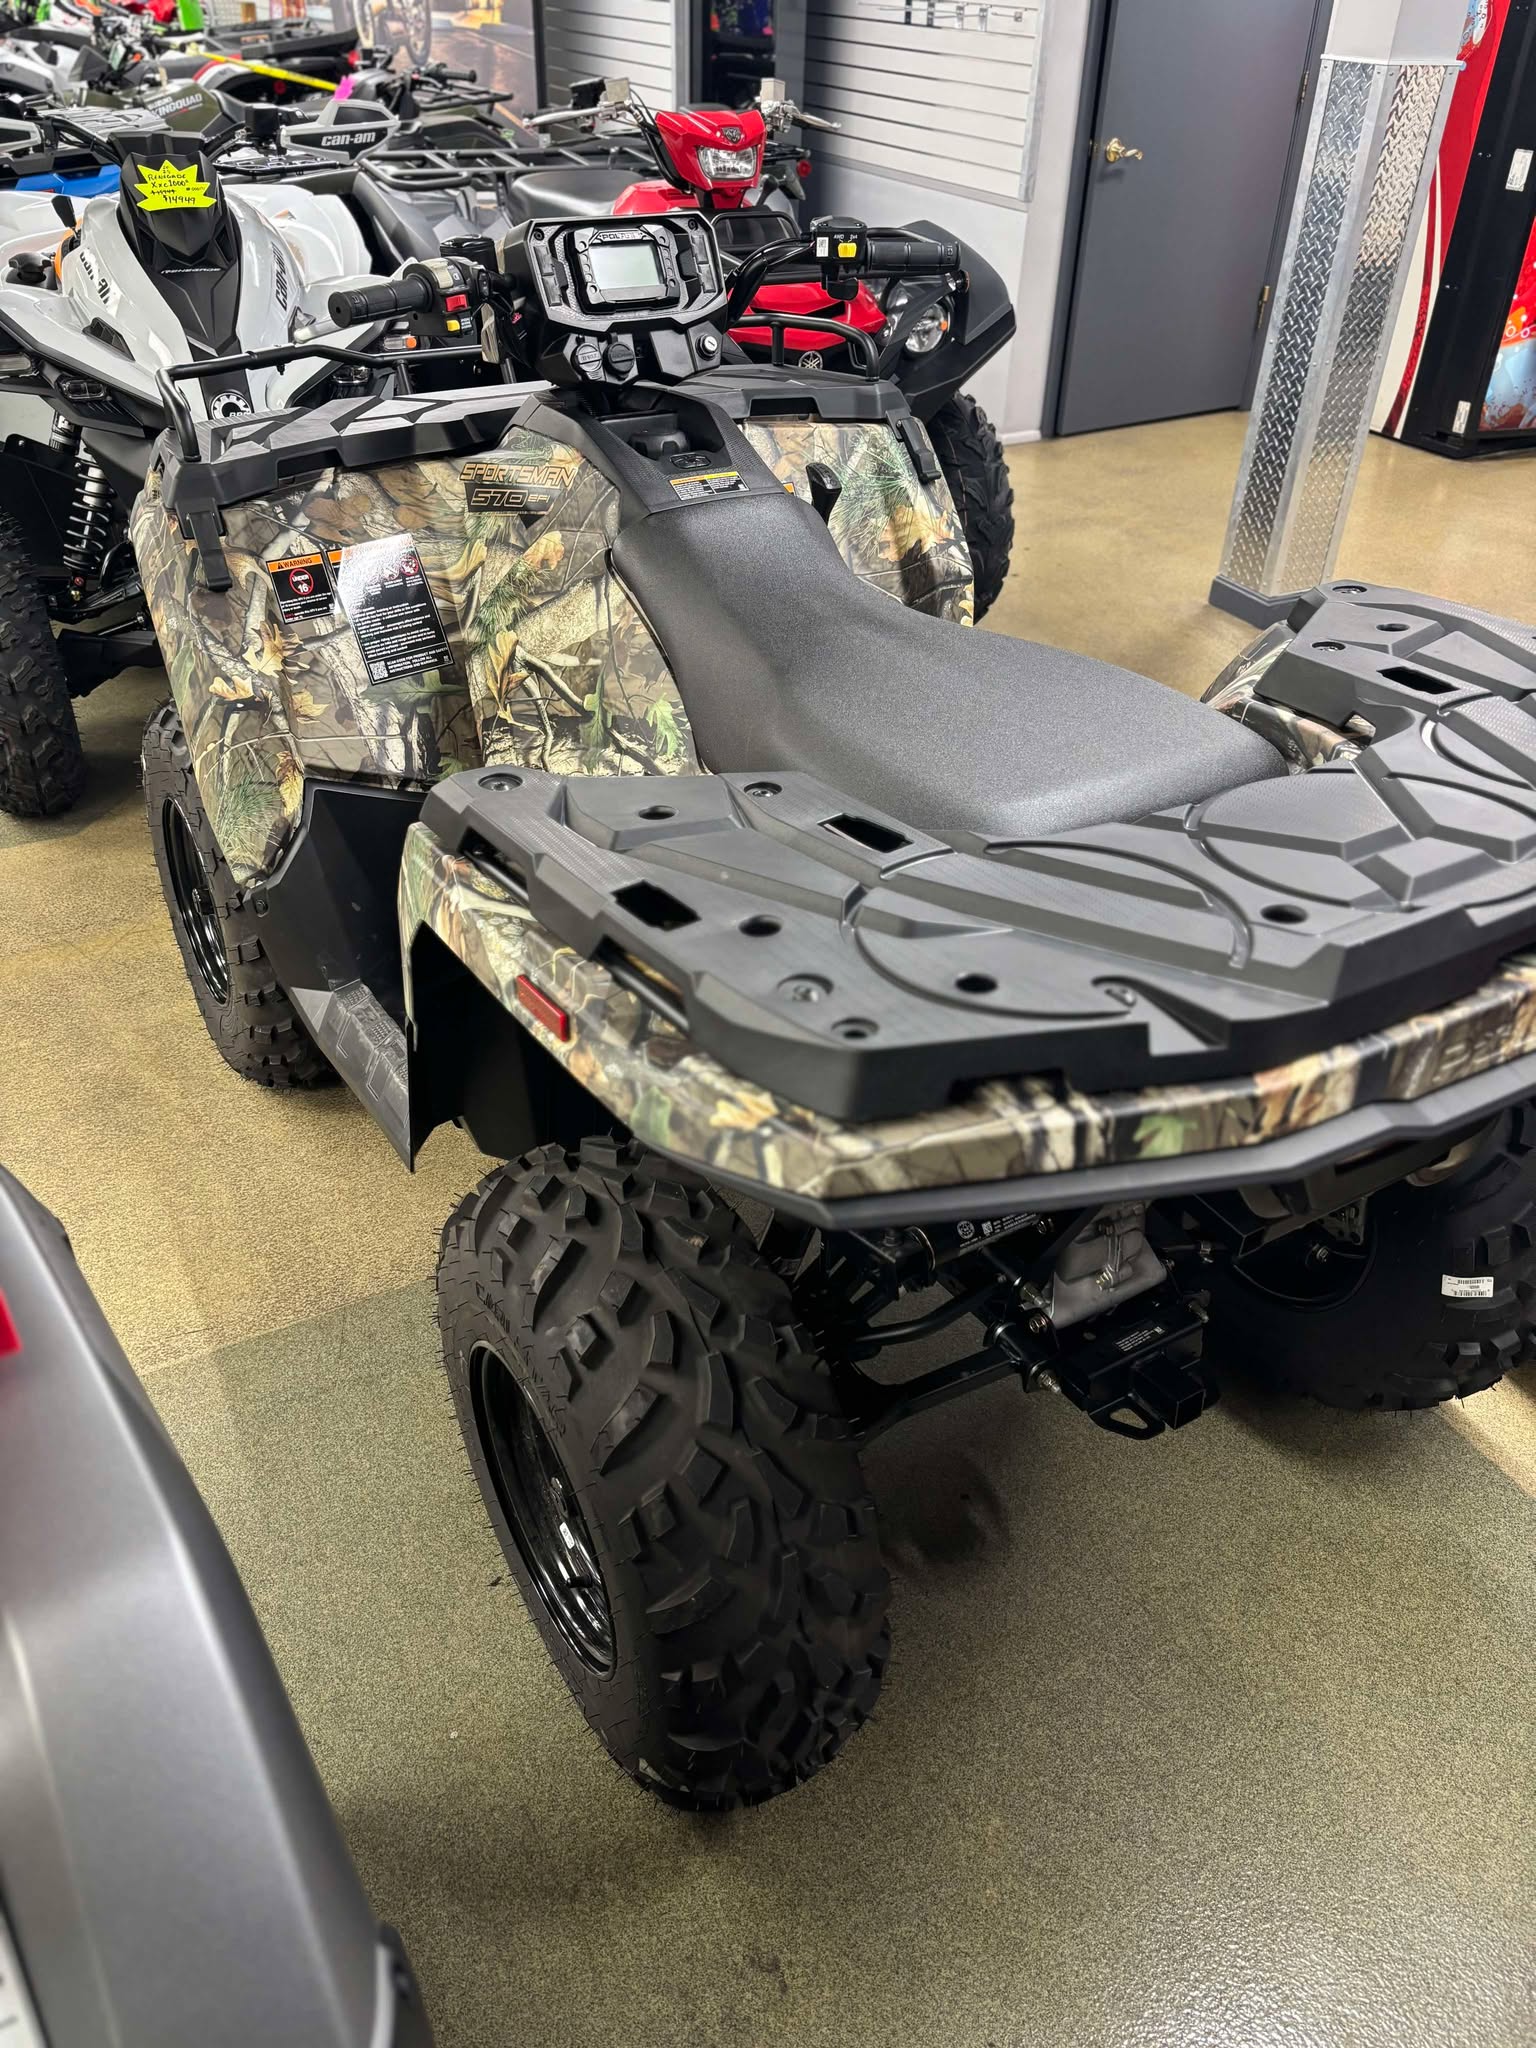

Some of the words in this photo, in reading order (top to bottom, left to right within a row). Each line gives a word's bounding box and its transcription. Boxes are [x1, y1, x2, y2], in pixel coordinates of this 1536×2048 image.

[321, 132, 376, 146] can-am
[460, 463, 577, 489] SPORTSMAN
[471, 489, 528, 508] 570
[283, 557, 313, 569] WARNING
[292, 574, 309, 582] UNDER
[298, 583, 309, 593] 16
